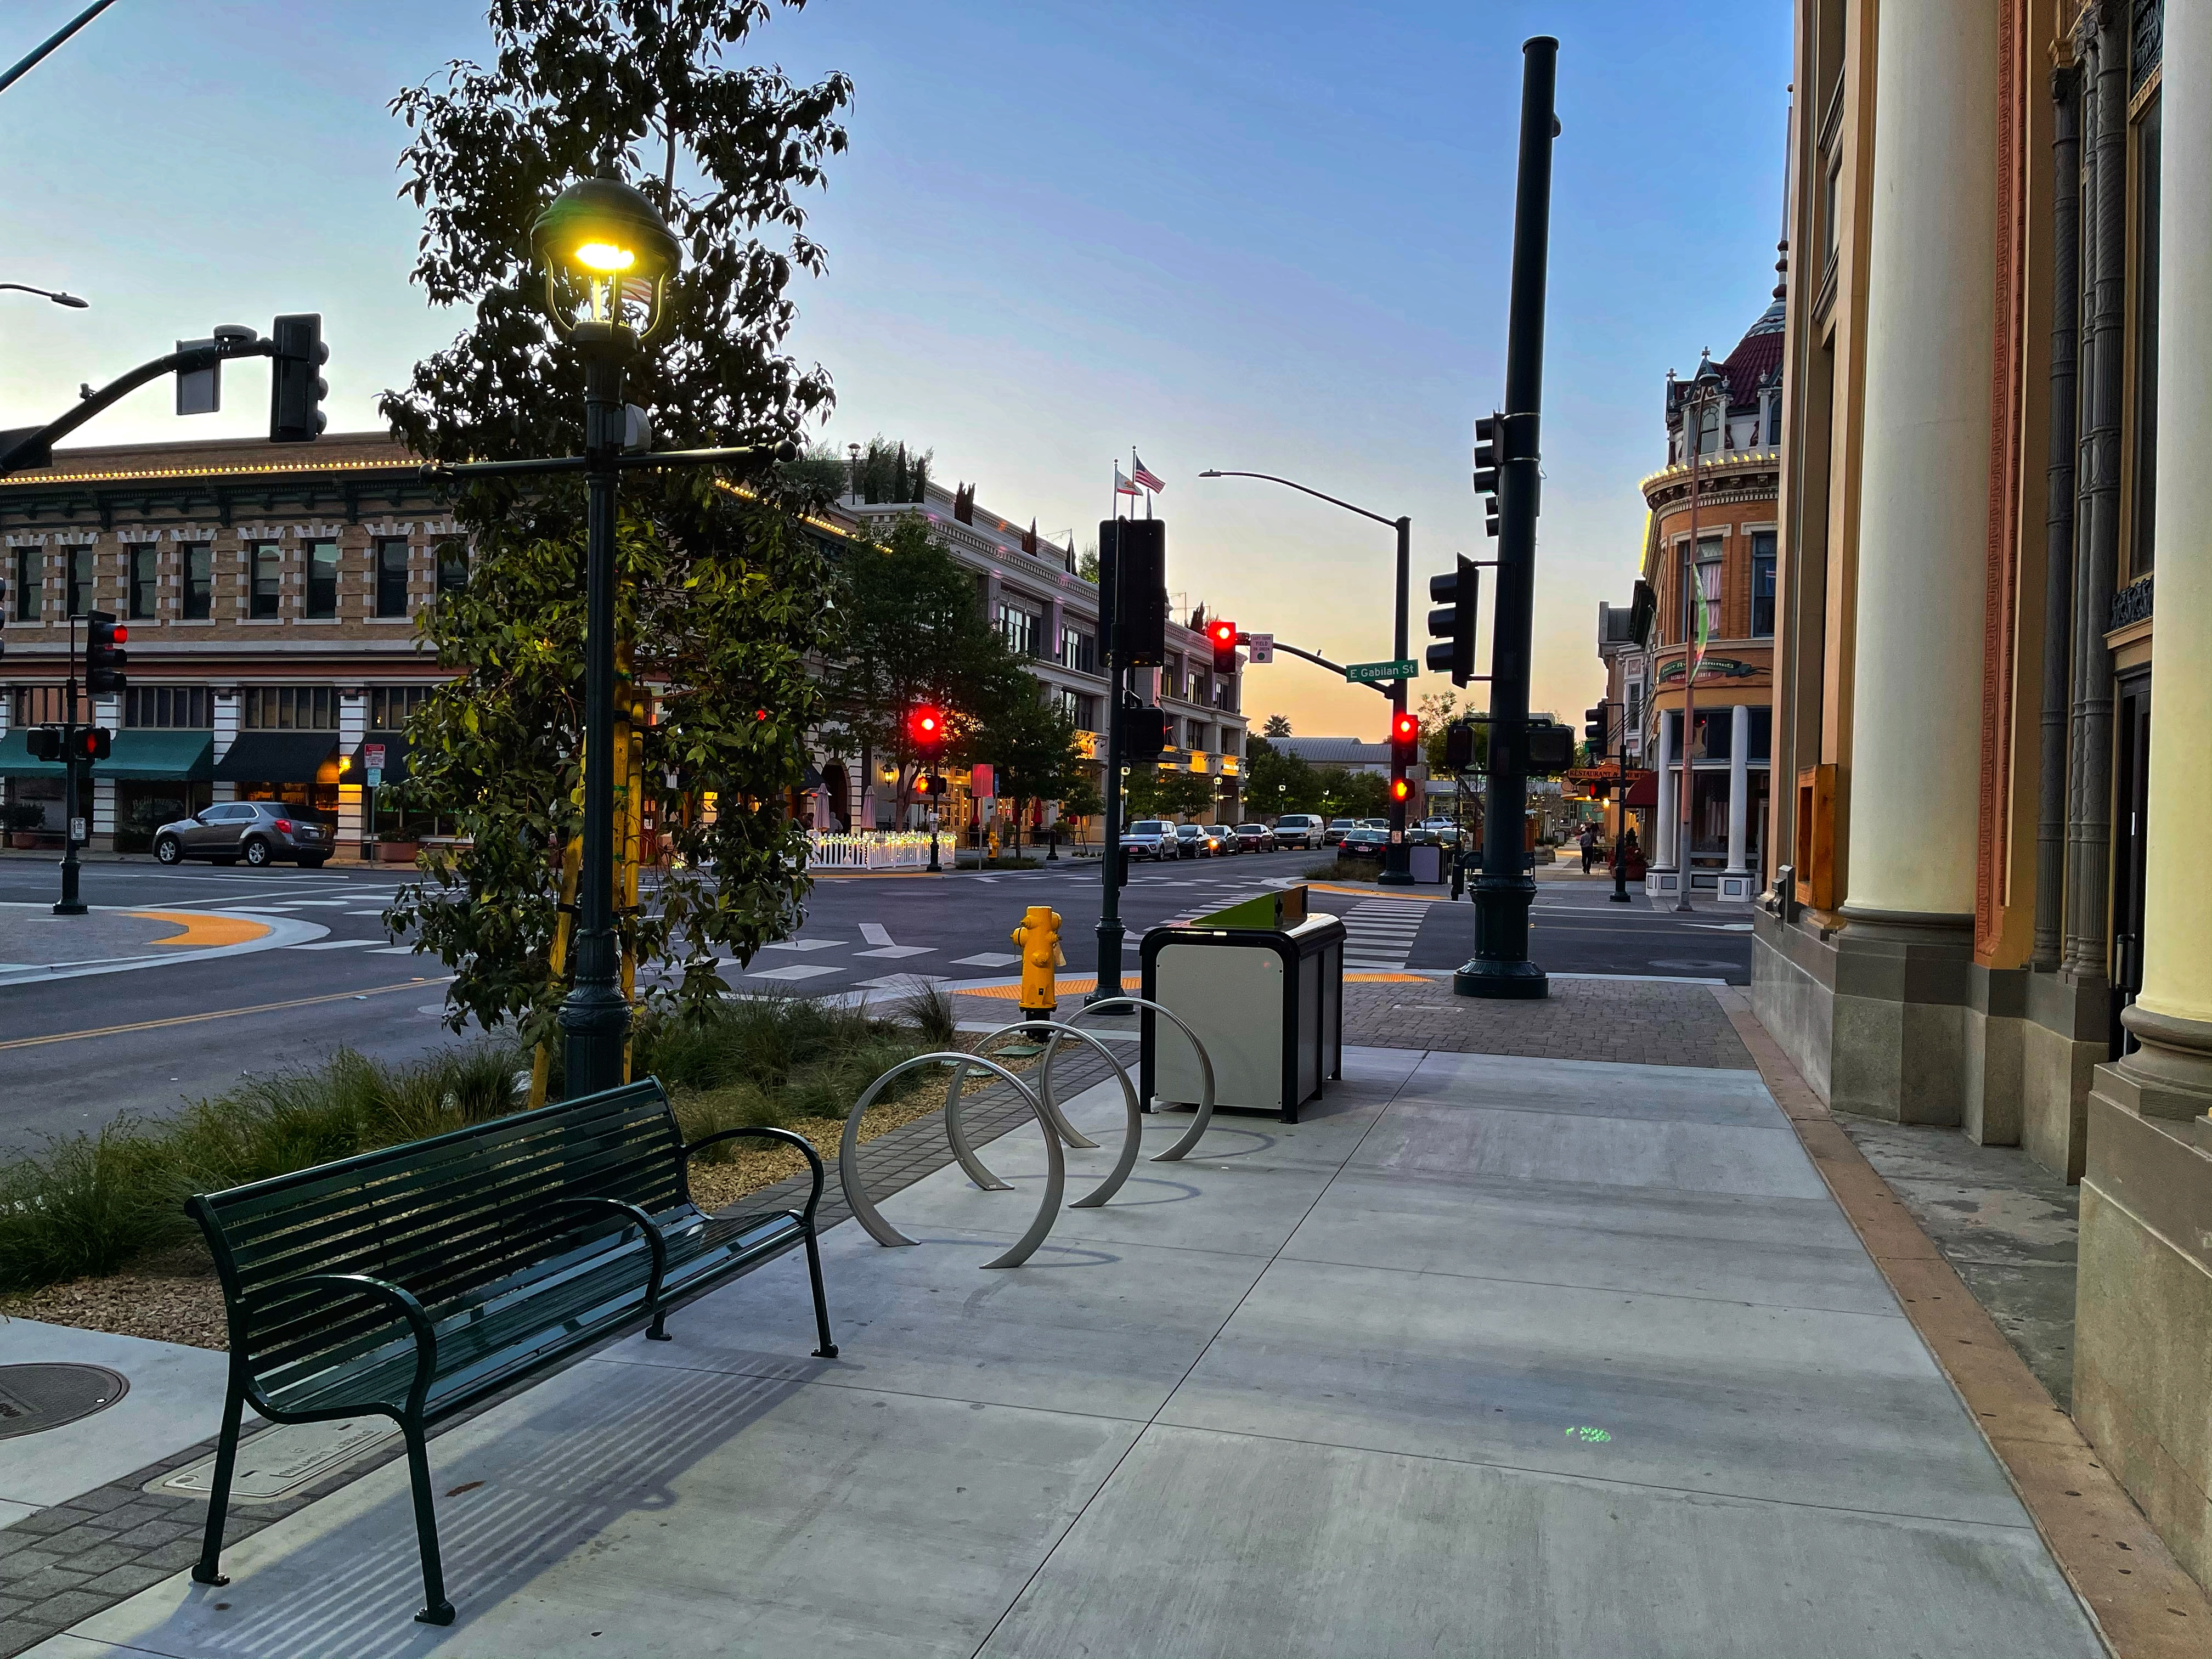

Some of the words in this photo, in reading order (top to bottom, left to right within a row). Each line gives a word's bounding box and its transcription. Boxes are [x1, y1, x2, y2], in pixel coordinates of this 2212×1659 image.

[1350, 669, 1357, 678] E
[1361, 666, 1399, 678] Gabilan
[1402, 664, 1414, 674] St
[279, 1451, 333, 1475] LIGHTING
